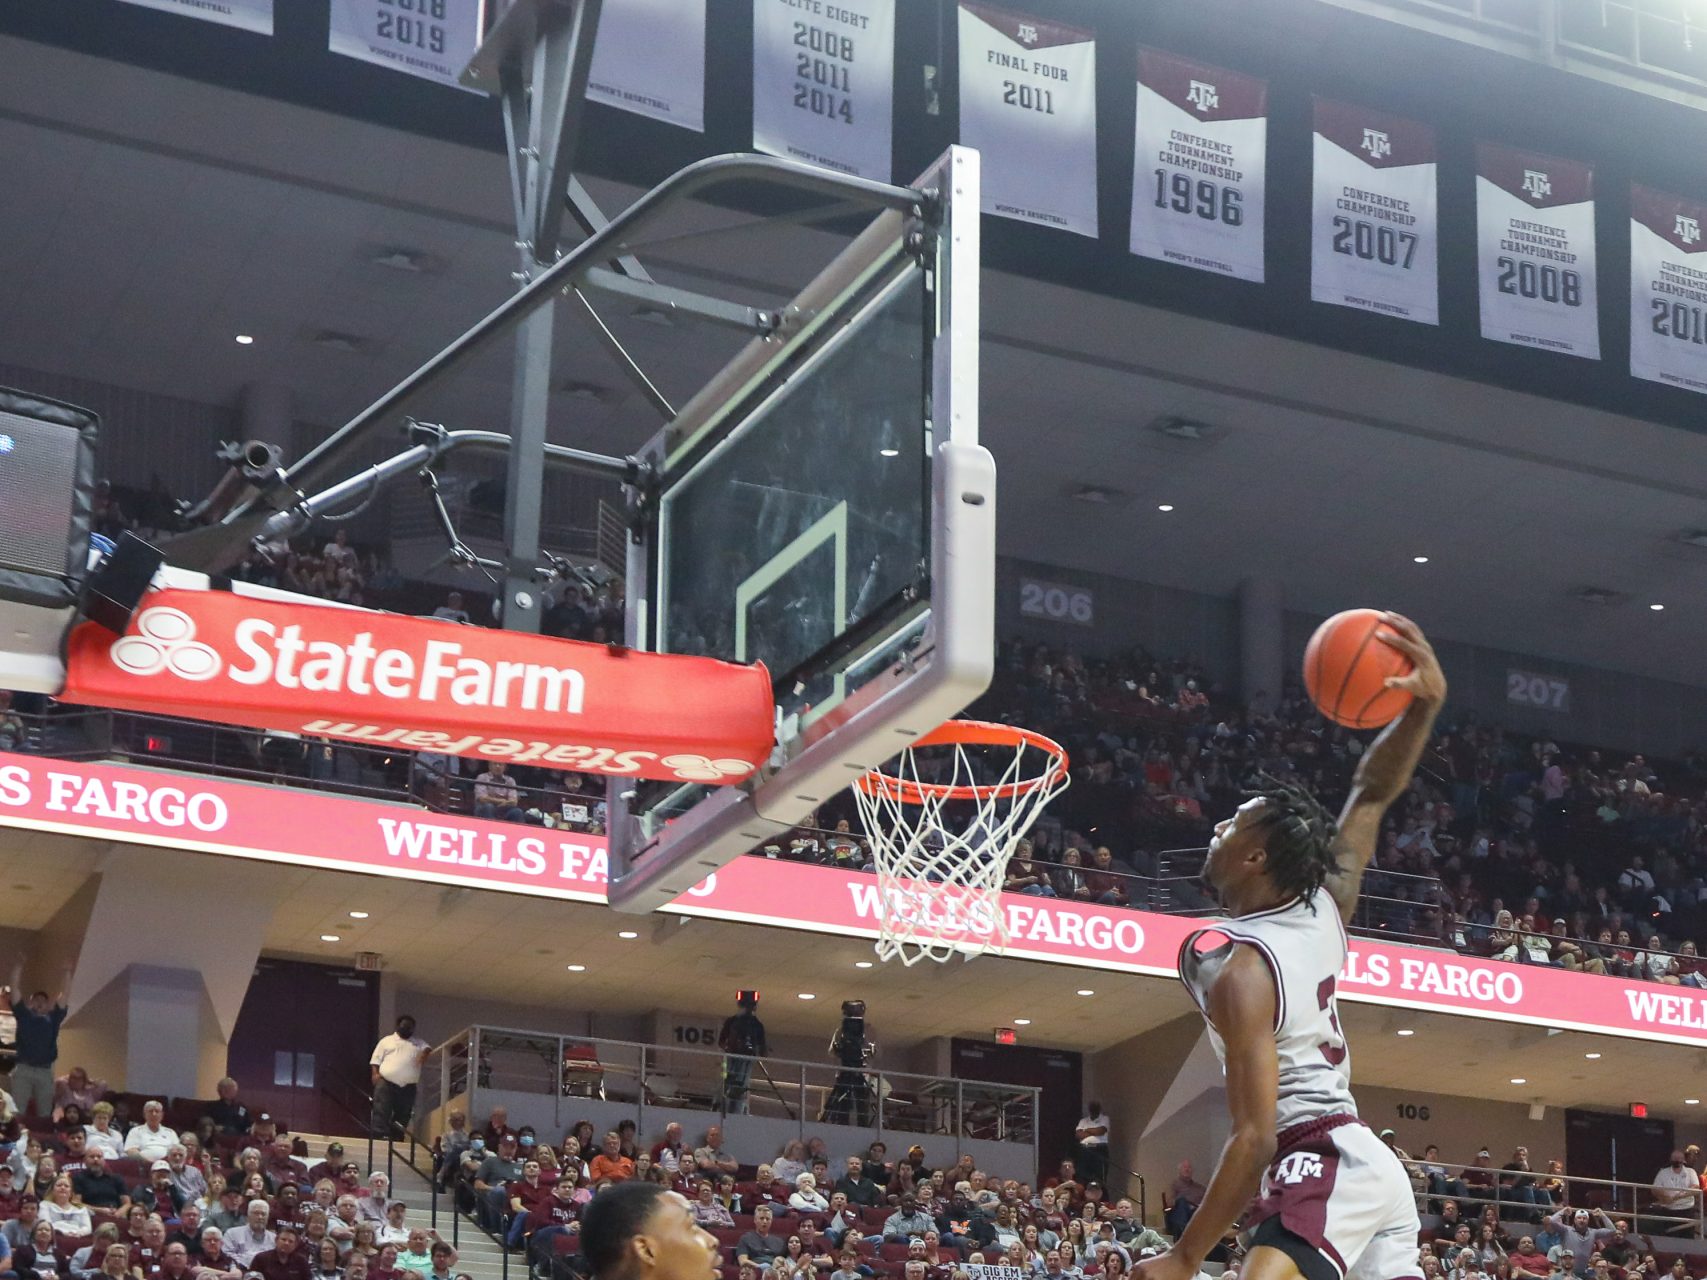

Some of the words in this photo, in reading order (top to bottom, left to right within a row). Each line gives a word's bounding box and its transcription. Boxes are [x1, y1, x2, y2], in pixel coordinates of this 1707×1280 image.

[377, 9, 444, 54] 2019
[826, 5, 869, 29] EIGHT
[793, 21, 854, 62] 2008
[796, 52, 850, 92] 2011
[987, 50, 1028, 72] FINAL
[1033, 62, 1068, 82] FOUR
[793, 82, 853, 125] 2014
[1003, 80, 1054, 115] 2011
[1168, 141, 1235, 167] TOURNAMENT
[1171, 130, 1232, 155] CONFERENCE
[1159, 151, 1243, 182] CHAMPIONSHIP
[1155, 168, 1243, 226] 1996
[1337, 198, 1416, 226] CHAMPIONSHIP
[1343, 186, 1410, 212] CONFERENCE
[1333, 215, 1419, 270] 2007
[1508, 229, 1568, 250] TOURNAMENT
[1510, 218, 1566, 238] CONFERENCE
[1500, 239, 1577, 264] CHAMPIONSHIP
[1498, 256, 1582, 307] 2008
[1652, 298, 1707, 346] 201
[1021, 583, 1091, 622] 206
[1506, 673, 1568, 708] 207
[46, 771, 228, 832] FARGO
[378, 818, 546, 875] WELLS
[848, 882, 996, 935] WELLS
[1007, 904, 1145, 954] FARGO
[1400, 958, 1523, 1005] FARGO
[674, 1026, 715, 1044] 105
[1396, 1104, 1430, 1121] 106
